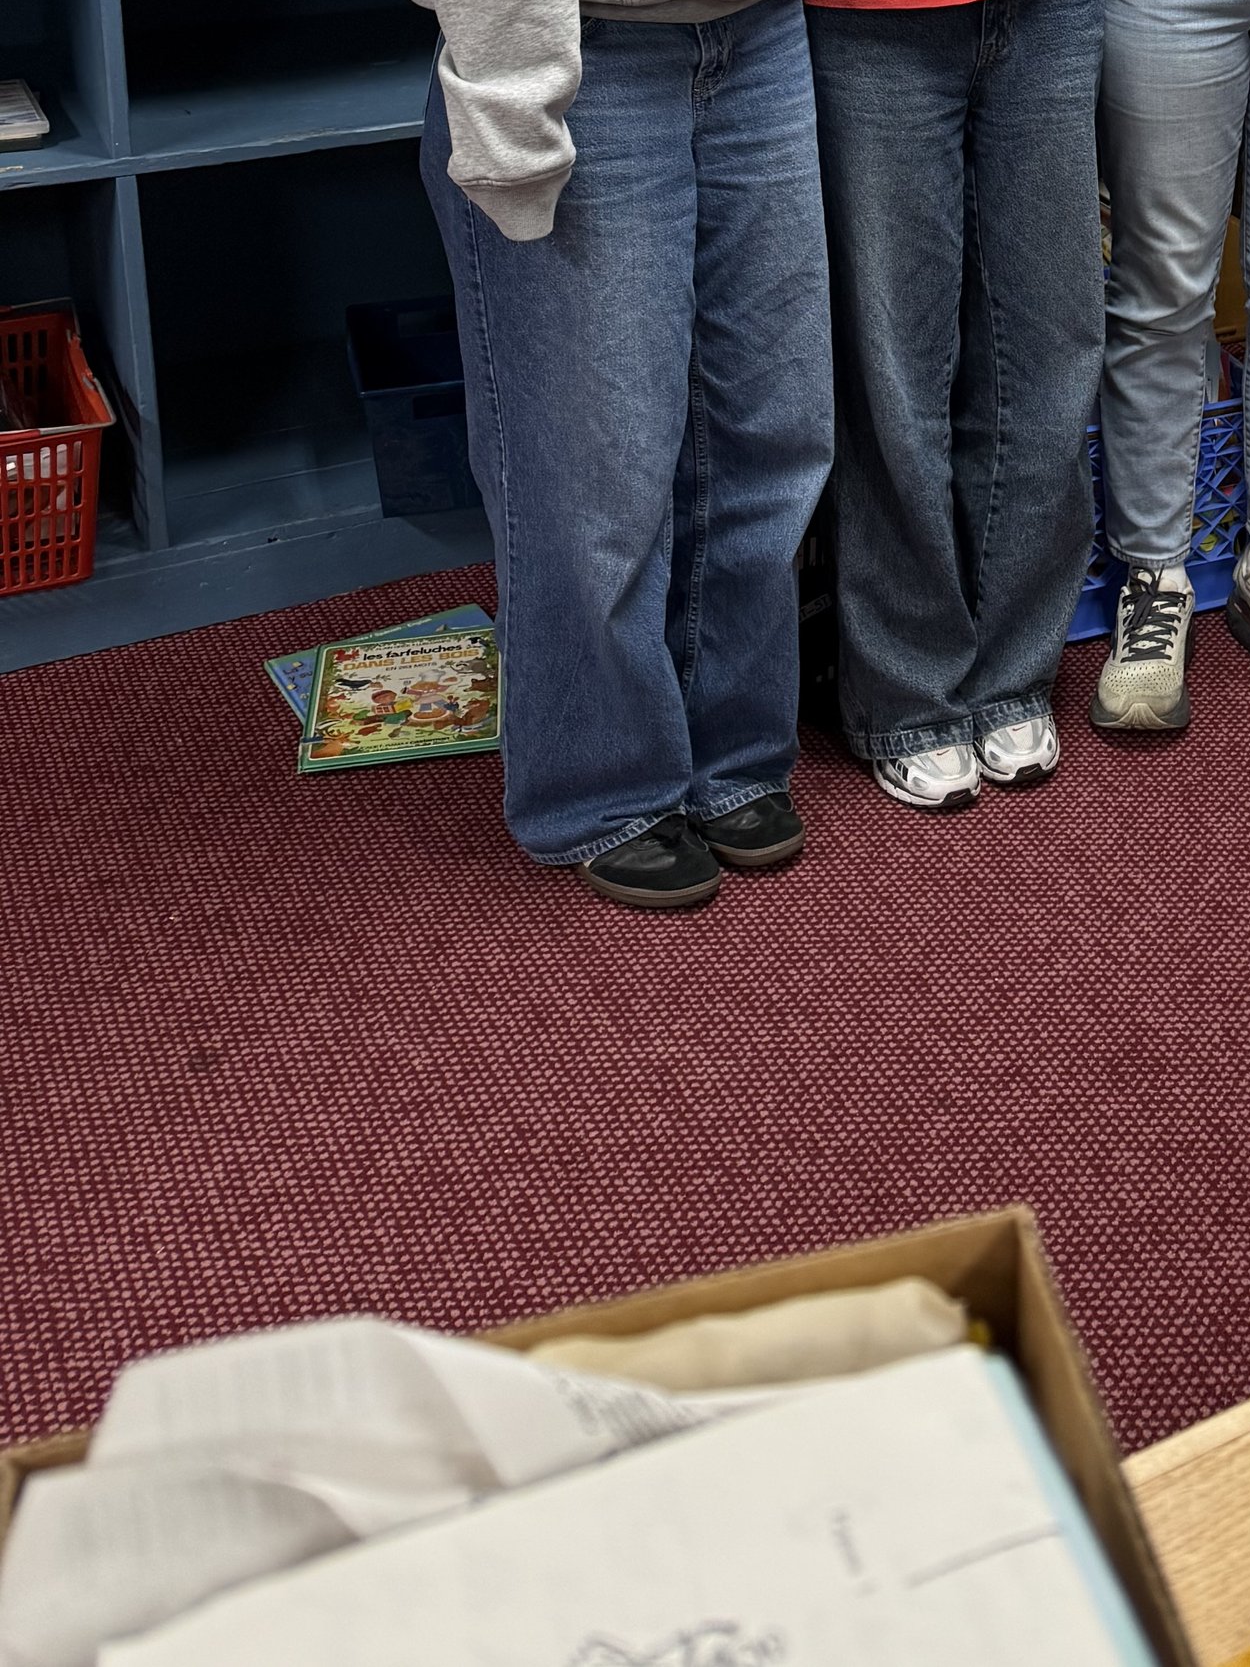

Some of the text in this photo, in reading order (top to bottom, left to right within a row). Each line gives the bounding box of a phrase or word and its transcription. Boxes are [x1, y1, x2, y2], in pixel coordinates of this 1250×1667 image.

[343, 649, 480, 671] DANS LES BOIS
[363, 653, 383, 661] les
[386, 644, 462, 658] farfeluches
